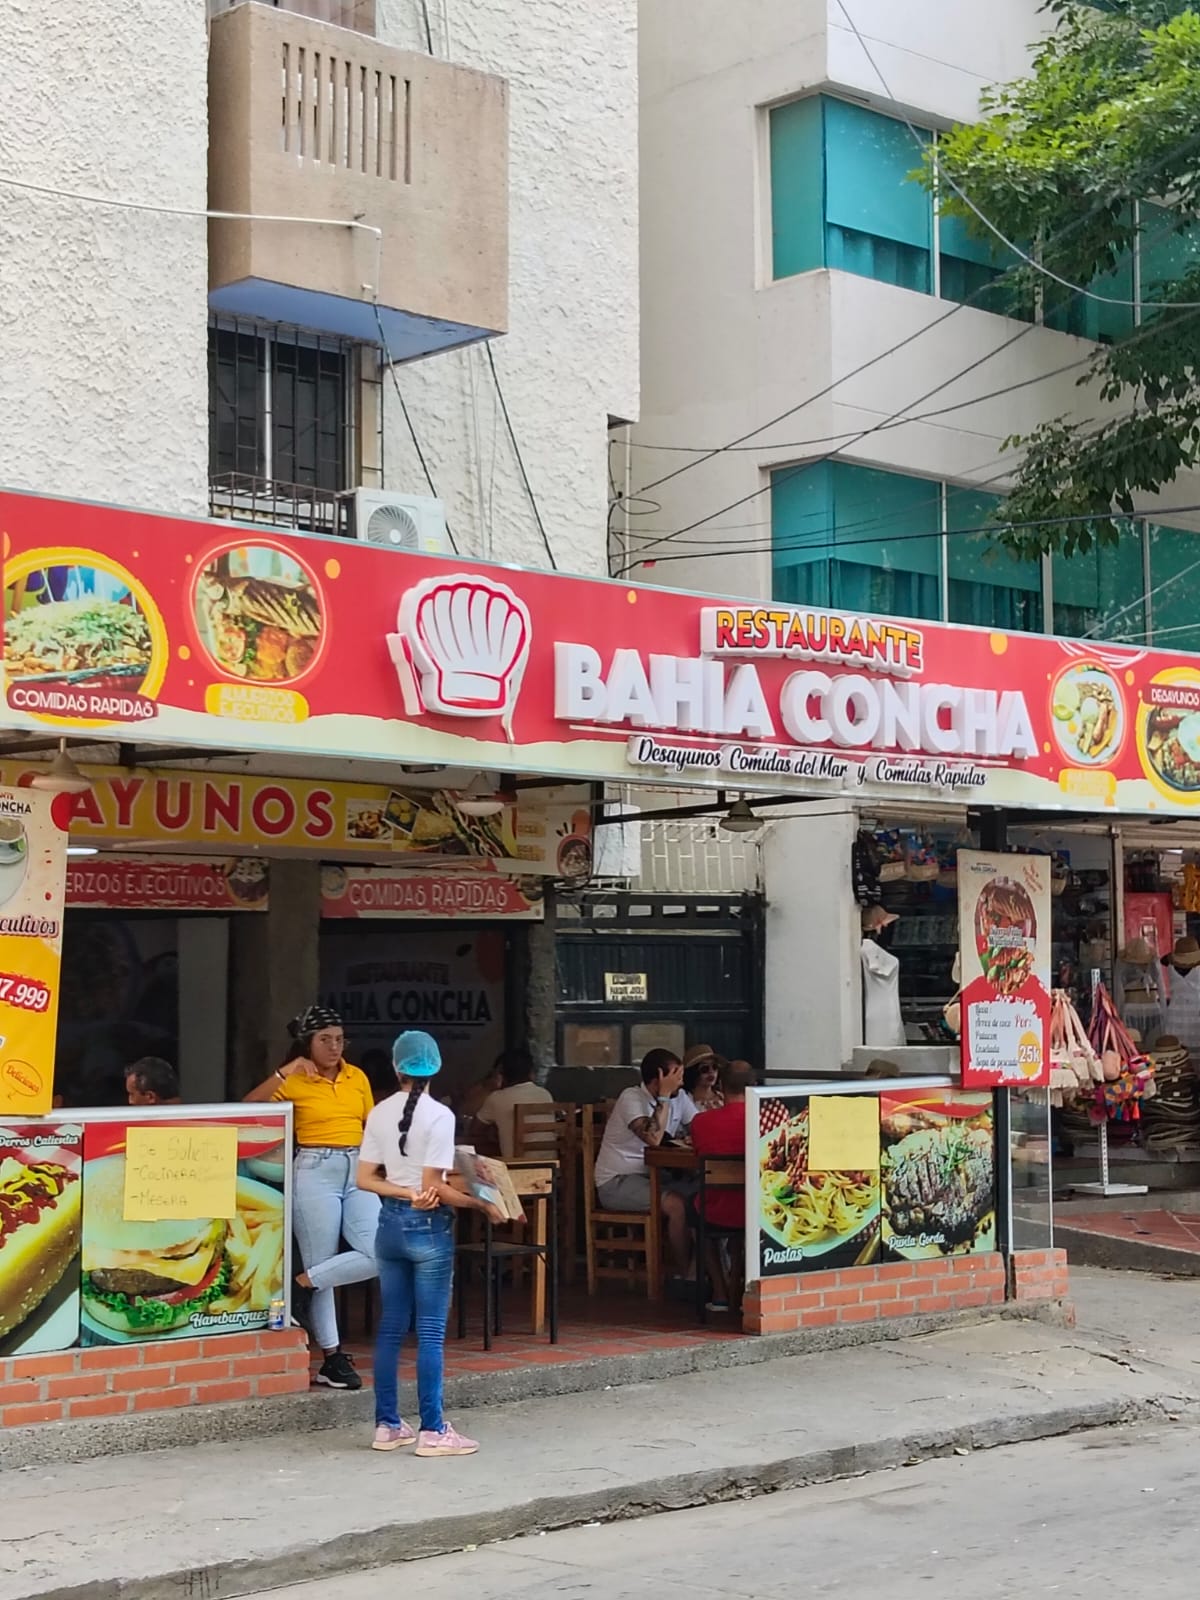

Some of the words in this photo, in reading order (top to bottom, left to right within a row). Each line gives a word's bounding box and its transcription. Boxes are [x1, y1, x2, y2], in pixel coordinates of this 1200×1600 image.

[716, 610, 922, 670] RESTAURANTE
[12, 688, 87, 712] COMIDAS
[90, 697, 154, 718] RAPIDAS
[554, 641, 776, 738] BAHIA
[780, 670, 1039, 758] CONCHA
[638, 738, 721, 772] Desayunos
[730, 747, 791, 773] Comidas
[794, 754, 817, 776] del
[819, 756, 848, 777] Mar
[876, 759, 931, 784] Comidas
[934, 763, 987, 791] Rapidas
[0, 801, 32, 814] NCHA
[125, 874, 226, 896] EJECUTIVOS
[350, 883, 427, 906] COMIDAS
[431, 884, 508, 907] RAPIDAS
[318, 990, 381, 1021] AHIA
[386, 989, 492, 1022] CONCHA
[33, 1133, 79, 1147] Calientes
[919, 1231, 945, 1247] Gorda
[763, 1247, 804, 1267] Pastas
[189, 1310, 270, 1328] Hamburgues
